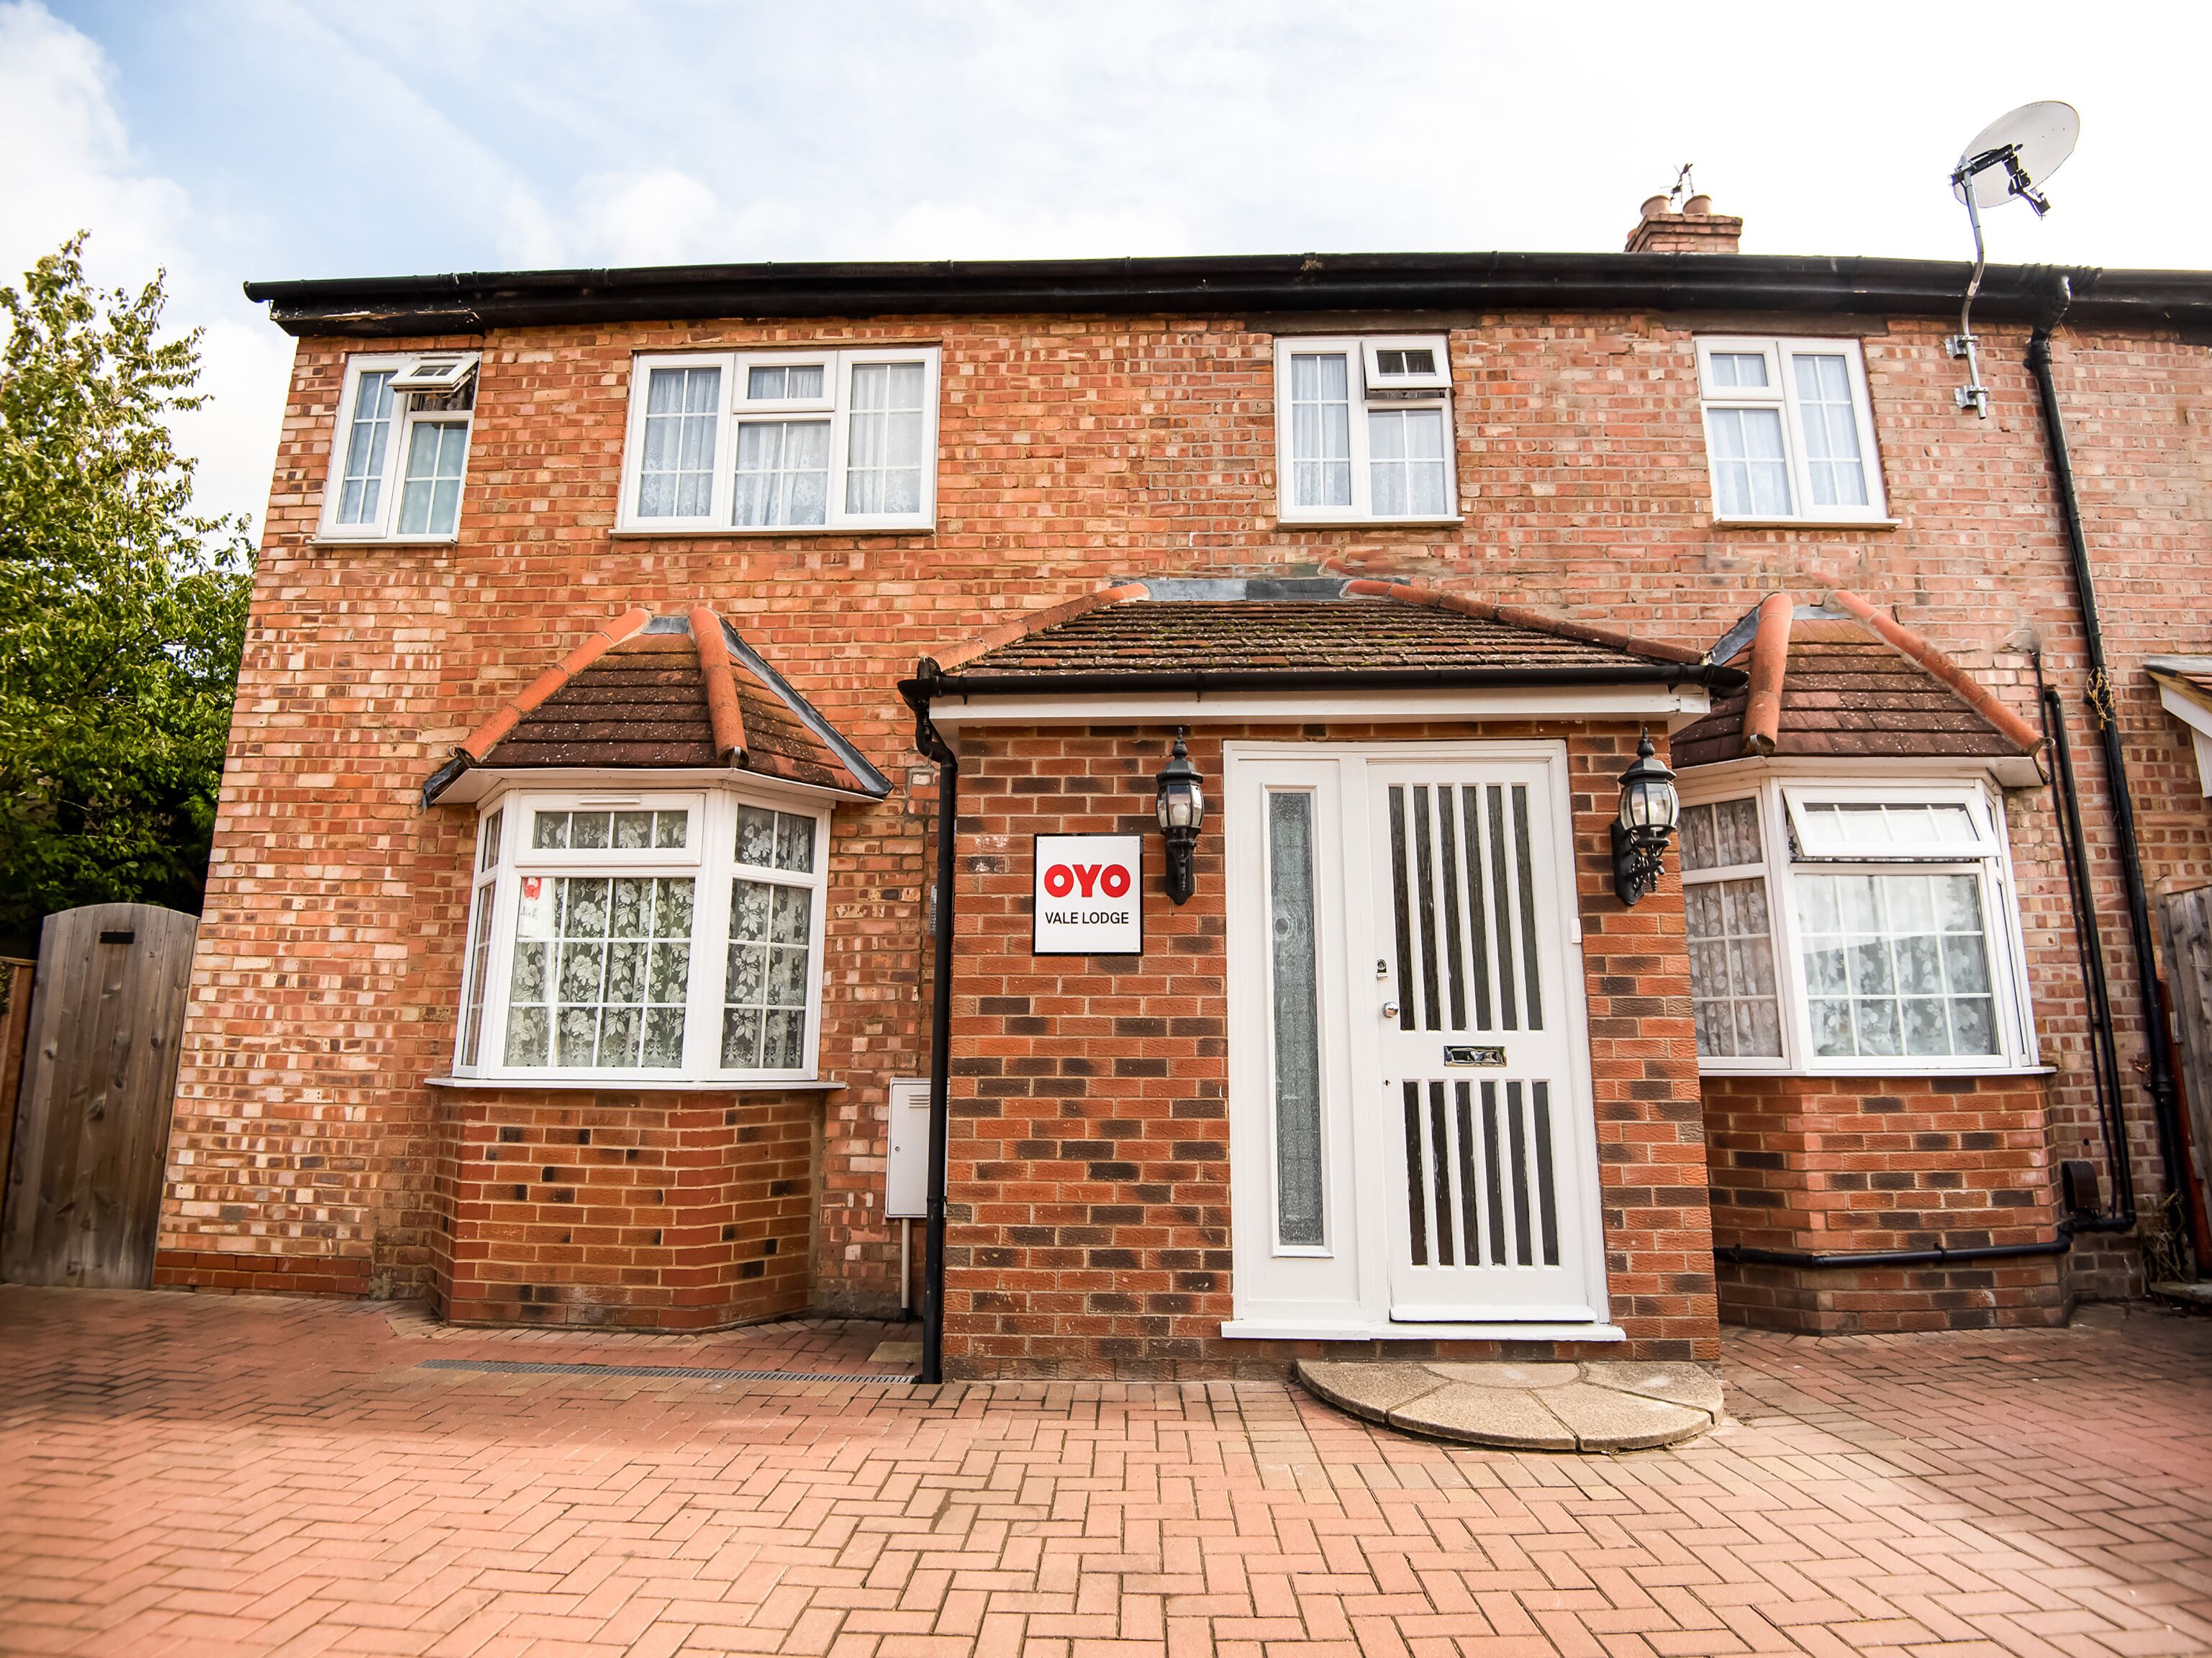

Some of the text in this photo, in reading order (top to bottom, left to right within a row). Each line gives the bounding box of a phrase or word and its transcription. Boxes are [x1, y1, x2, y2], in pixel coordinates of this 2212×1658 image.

[1044, 864, 1130, 897] OYO
[1045, 912, 1129, 924] VALE LODGE
